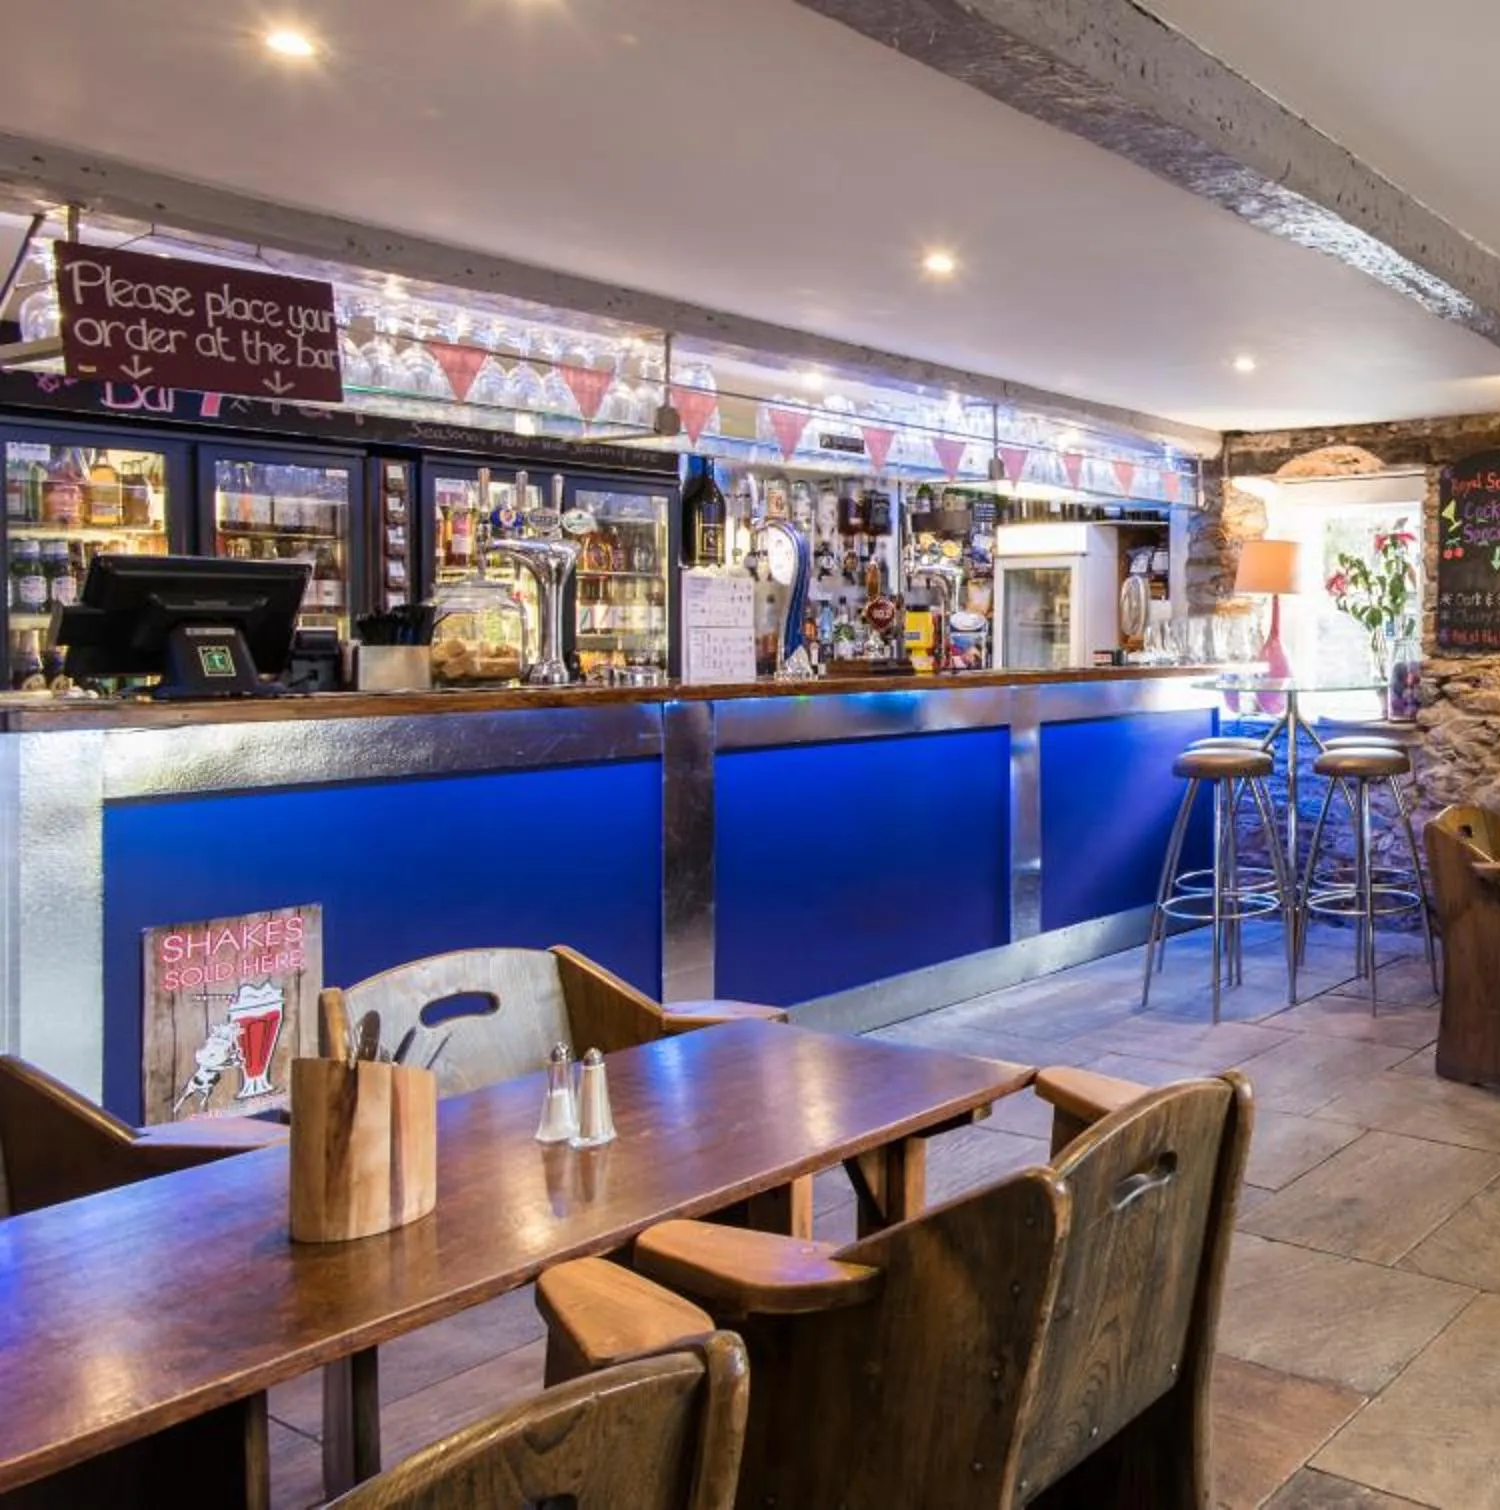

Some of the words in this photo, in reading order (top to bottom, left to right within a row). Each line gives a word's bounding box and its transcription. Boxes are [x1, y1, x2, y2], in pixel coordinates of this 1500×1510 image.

[64, 259, 195, 318] Please
[205, 283, 283, 328] place
[287, 304, 336, 341] your
[73, 317, 188, 355] order
[195, 328, 236, 362] at
[242, 330, 291, 367] the
[297, 331, 338, 371] bar
[162, 916, 304, 963] SHAKES
[164, 961, 235, 991] SOLD
[242, 949, 306, 977] HERE
